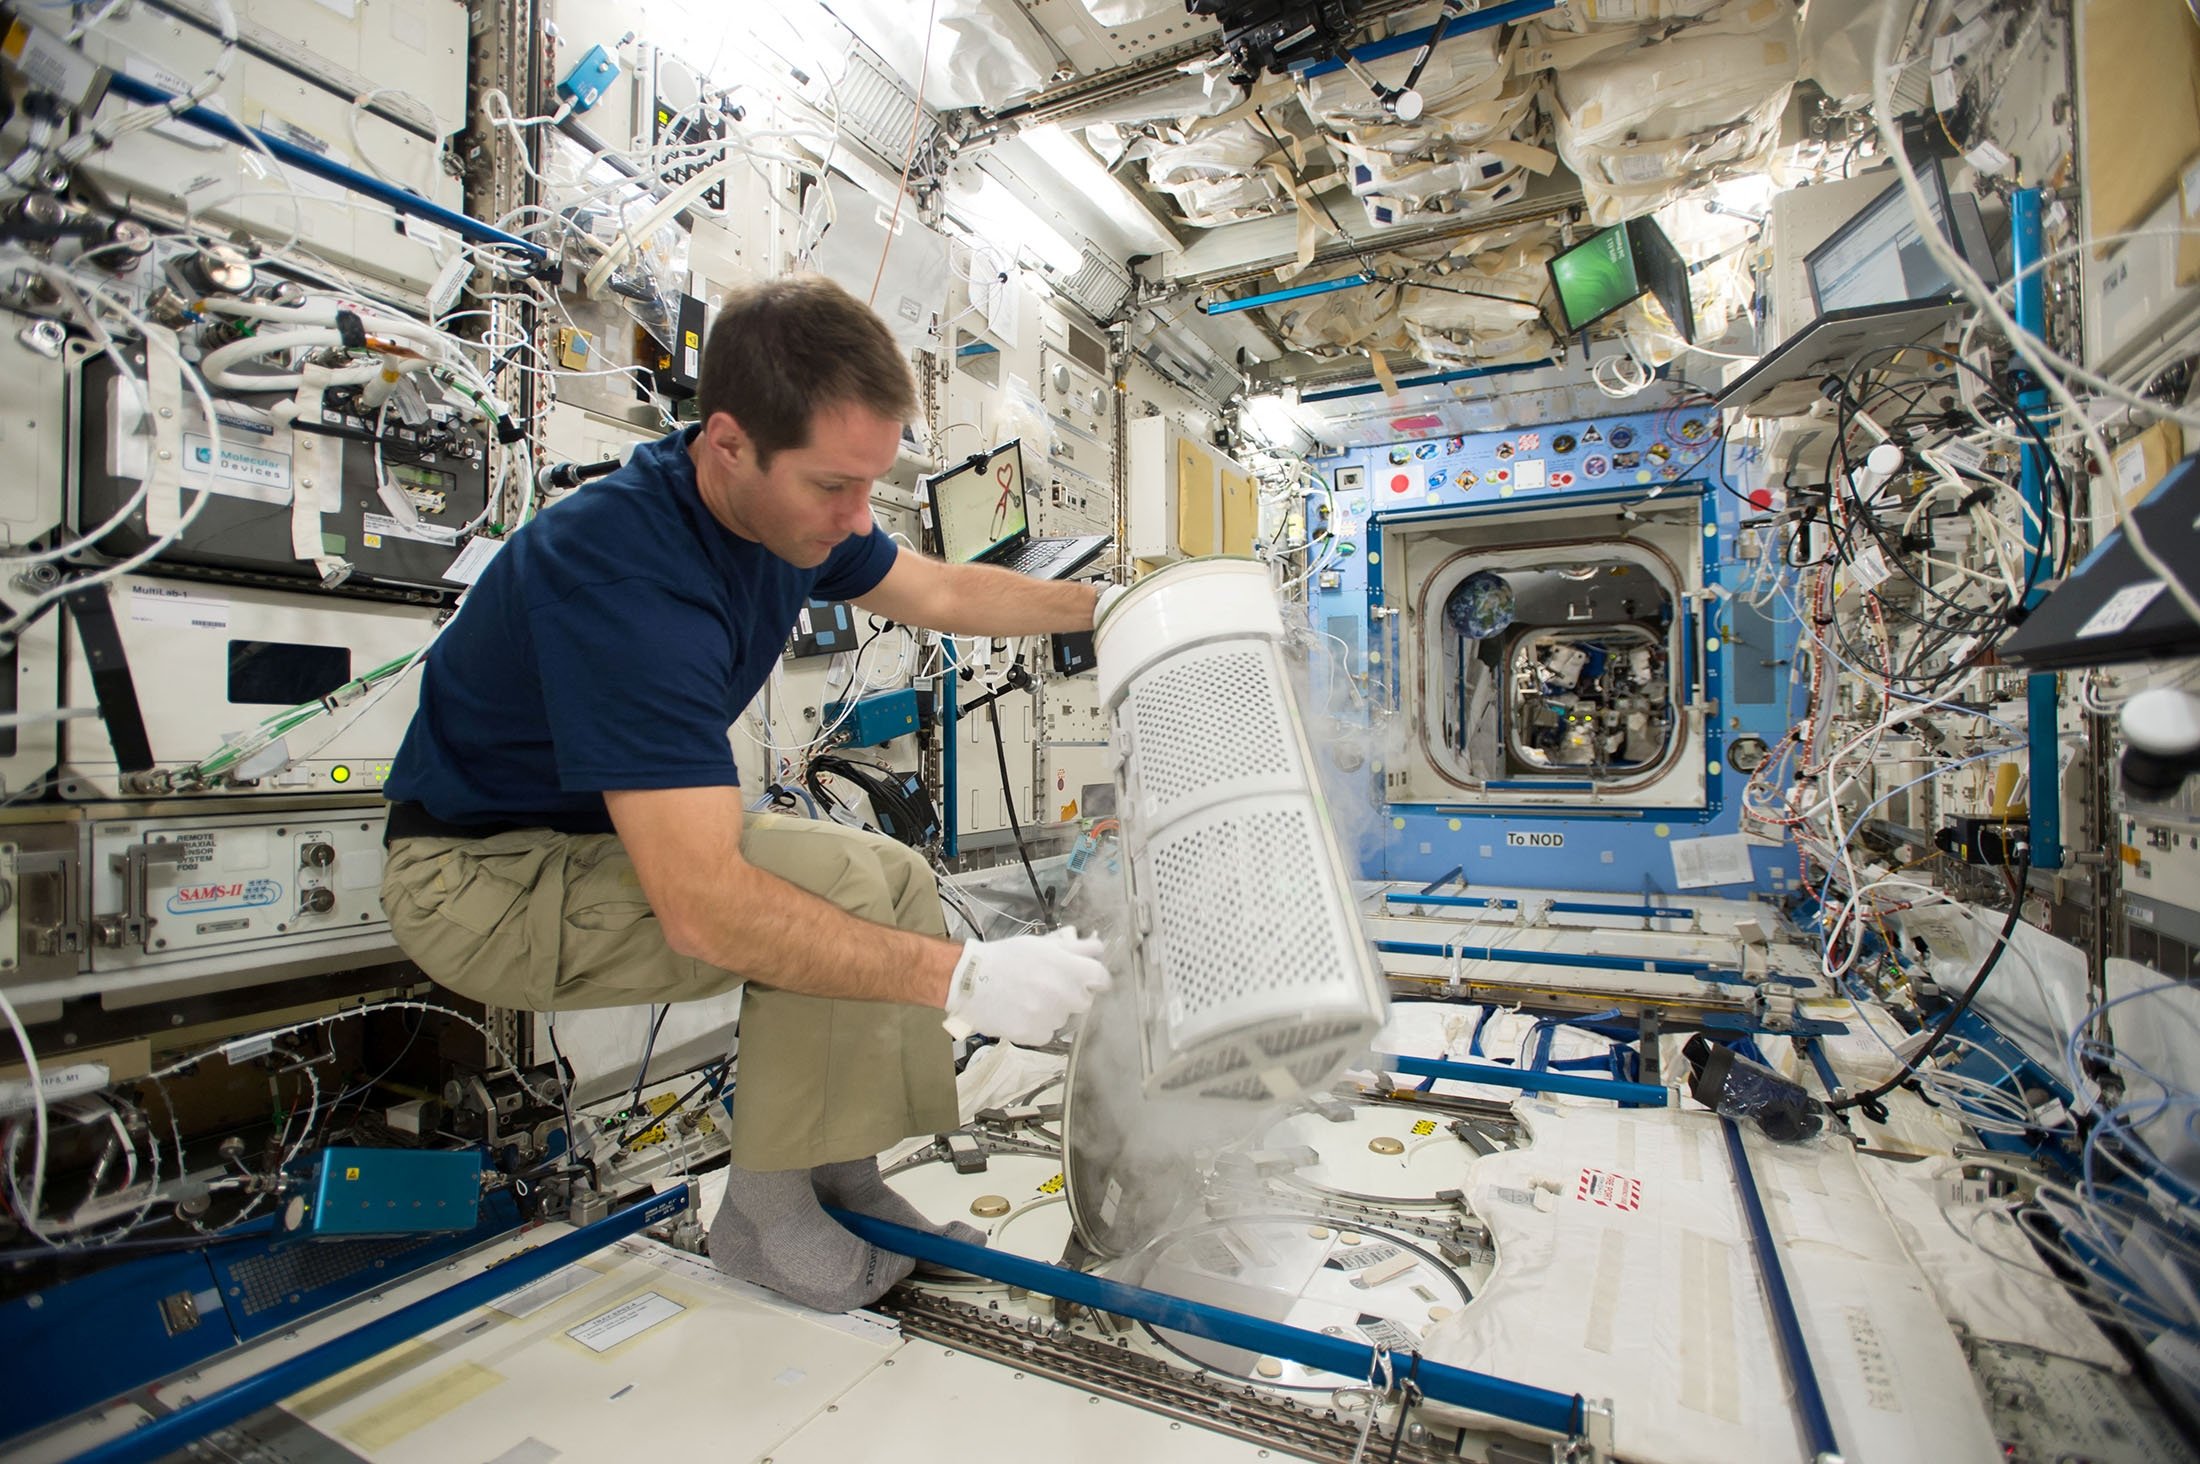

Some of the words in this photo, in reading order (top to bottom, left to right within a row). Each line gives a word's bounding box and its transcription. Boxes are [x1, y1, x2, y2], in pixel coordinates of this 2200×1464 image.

[220, 450, 280, 468] Molecular
[221, 460, 280, 478] Devices
[132, 585, 188, 598] MultiLab-1
[176, 833, 214, 842] REMOTE
[182, 840, 217, 848] RIAXIAL
[1508, 833, 1525, 845] To
[1530, 834, 1563, 846] NOD
[182, 847, 214, 856] ENSOR
[176, 863, 199, 871] FD02
[179, 883, 243, 902] SAMS-II
[1604, 1186, 1614, 1201] PORT
